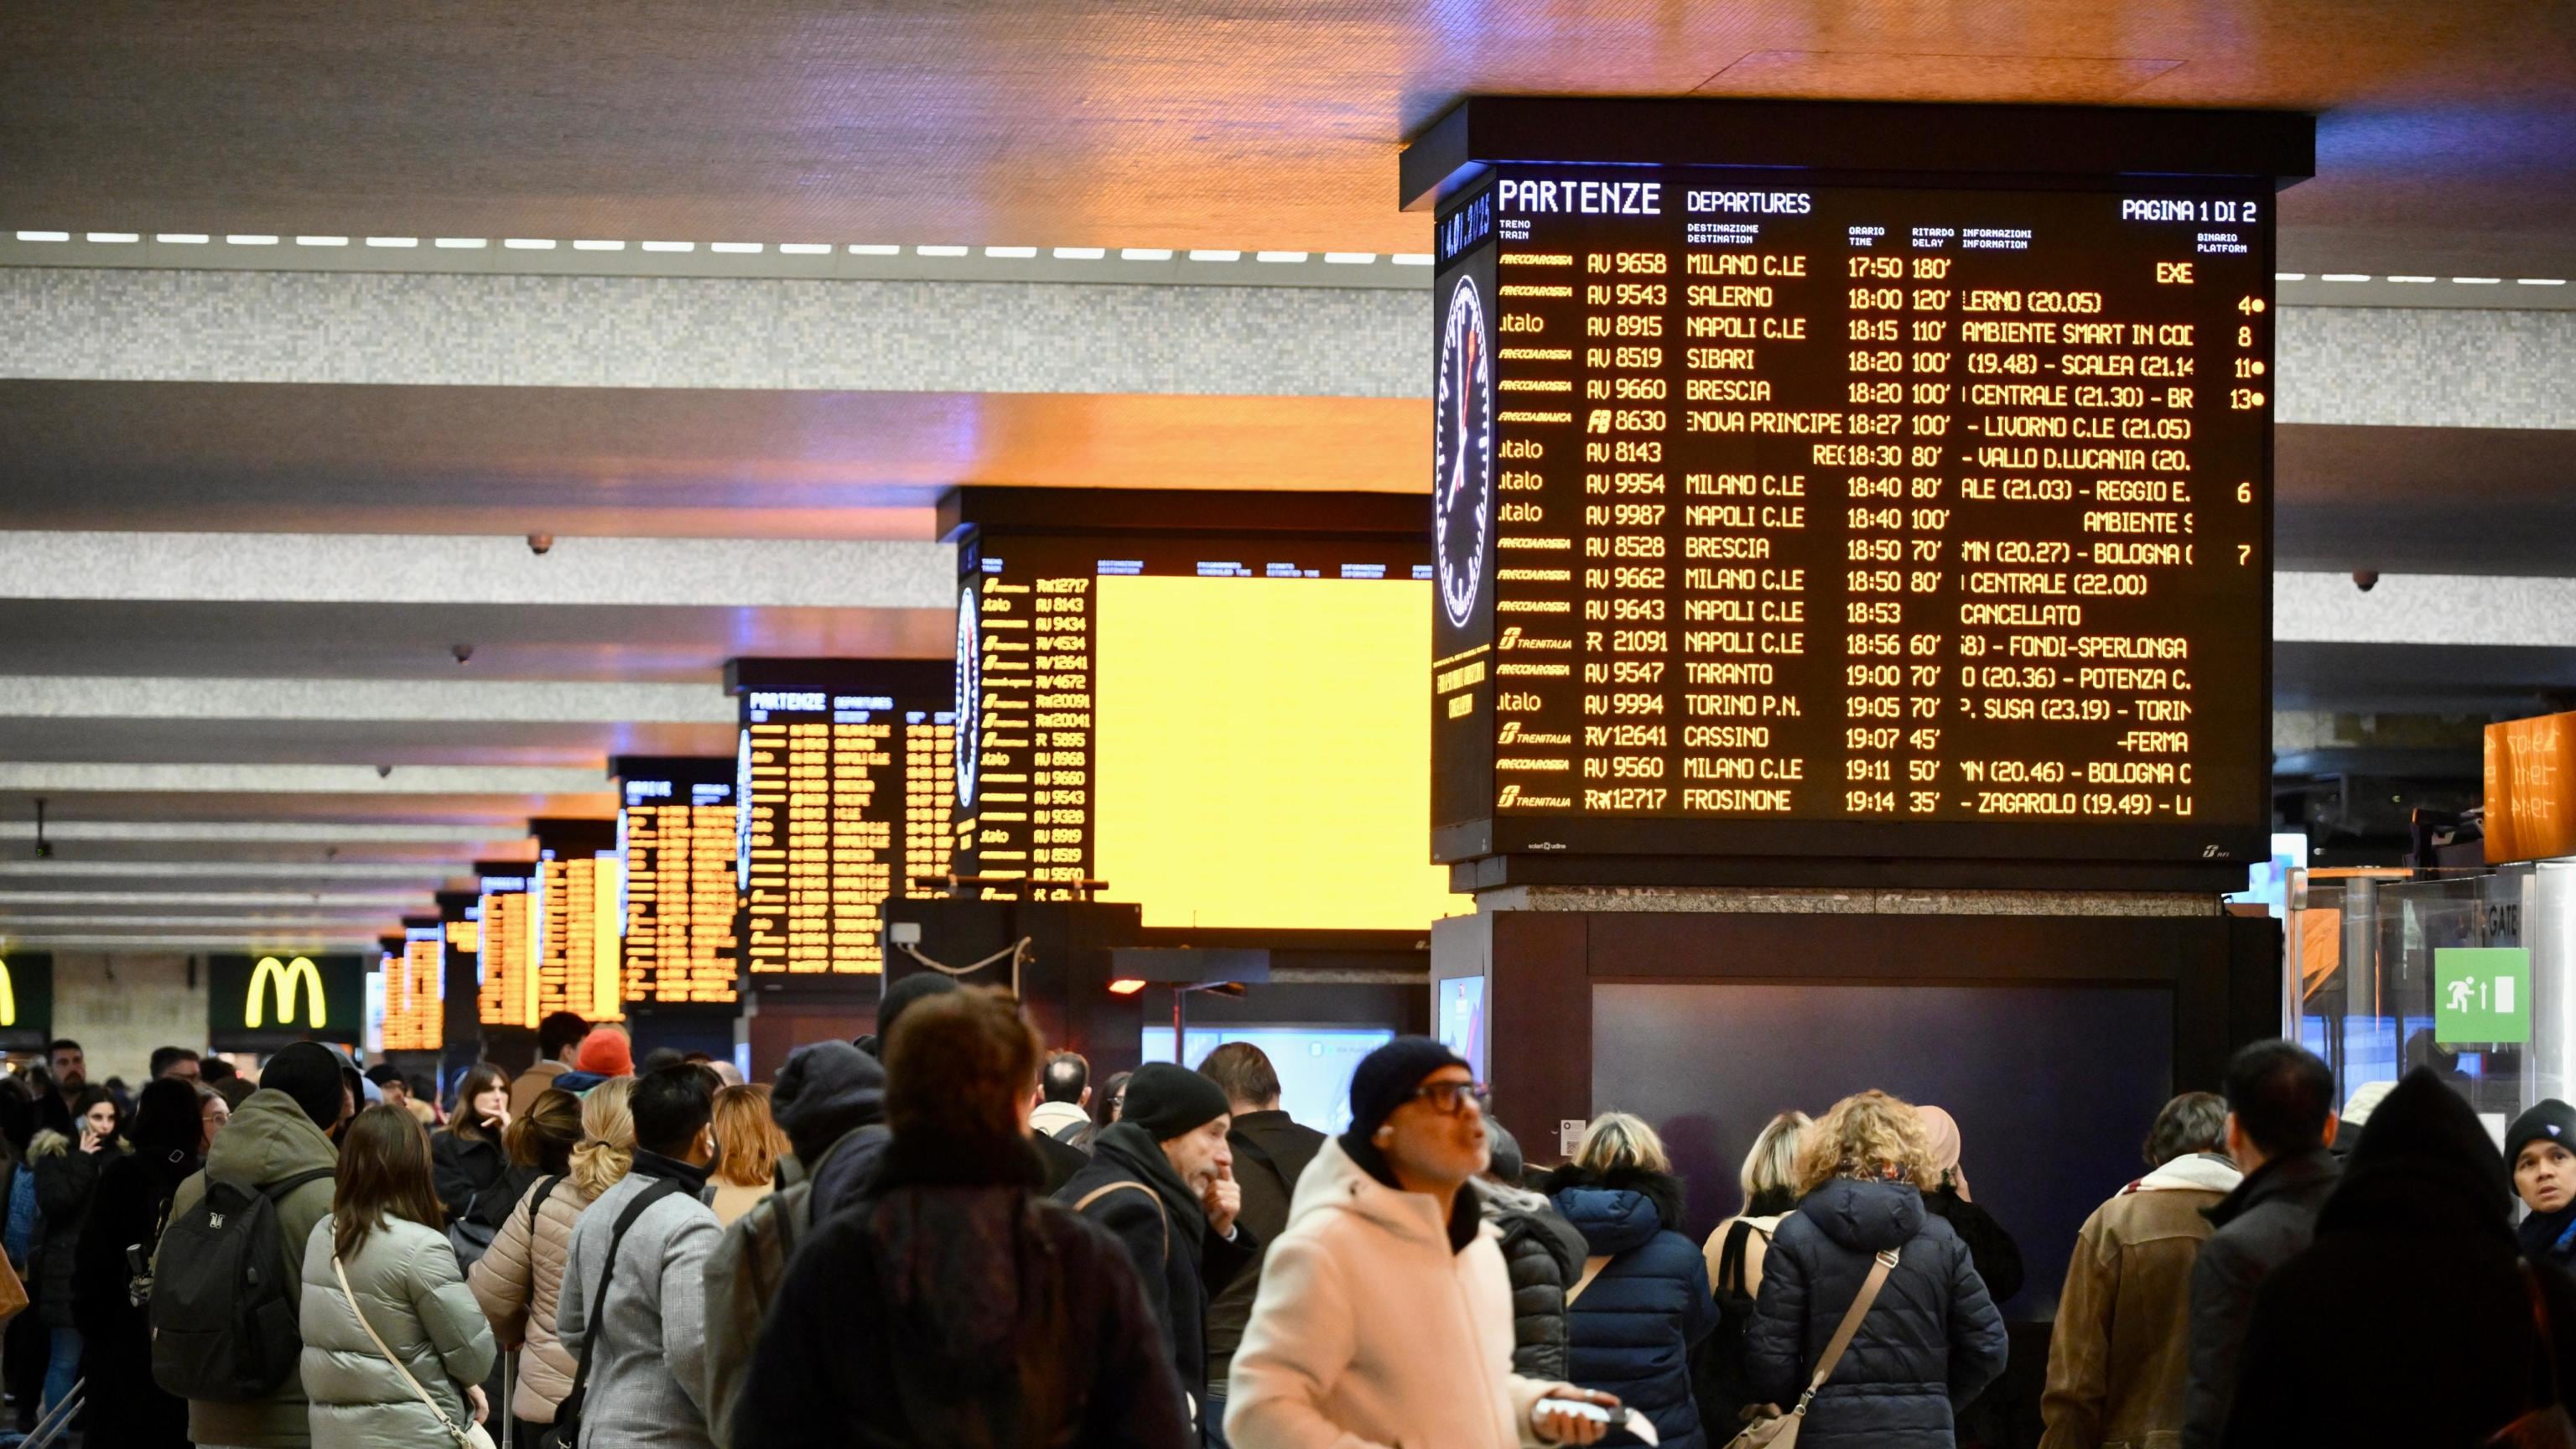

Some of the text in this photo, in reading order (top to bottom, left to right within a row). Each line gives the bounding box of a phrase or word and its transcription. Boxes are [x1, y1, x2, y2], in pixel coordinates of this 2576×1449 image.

[1499, 180, 1810, 214] PARTENZE DEPARTURES
[2123, 200, 2256, 221] PAGINA 1 DI 2
[1499, 220, 1530, 228] TRENO
[1499, 231, 1529, 239] TRAIN
[1688, 224, 1758, 233] DESTINAZIONE
[1913, 228, 1954, 236] RITARDO
[1963, 229, 2032, 238] INFORMAZIONI
[2198, 233, 2237, 242] BINARIO
[1688, 235, 1753, 243] DESTINATION
[1849, 237, 1872, 246] TIME
[1913, 239, 1943, 247] DELAY
[1963, 240, 2027, 248] INFORMATION
[2198, 244, 2246, 252] PLATFORM
[1588, 253, 1611, 273] AV
[1617, 252, 1667, 273] 9658
[1688, 254, 1758, 275] MILANO
[1763, 255, 1806, 276] C.LE
[1849, 257, 1903, 278] 17:50
[2157, 262, 2194, 283] EXE
[1587, 284, 2251, 315] AV 9543 SALERNO 18:00 LERNO (20.05) 4
[1587, 317, 1611, 337] AV
[1616, 315, 1663, 336] 8915
[1687, 316, 1757, 338] NAPOLI
[1763, 318, 1806, 339] C.LE
[1849, 319, 1898, 340] 18:15
[1962, 321, 2056, 343] AMBIENTE
[2063, 323, 2125, 344] SMART
[2132, 325, 2153, 345] IN
[2239, 326, 2251, 346] 8
[1587, 347, 2251, 378] AV 8519 SIBARI 18:20 (19.48) SCALEA 11
[1616, 378, 2251, 409] 9660 BRESCIA 18:20 CENTRALE (21.30) 13
[1616, 410, 1666, 431] 8630
[1751, 412, 1842, 434] PRINCIPE
[1848, 413, 1902, 434] 18:27
[1985, 416, 2066, 438] LIVORNO
[2073, 418, 2115, 439] C.LE
[2122, 418, 2191, 439] (21.05)
[1587, 441, 2146, 470] AV 8143 18:30 VALLO D.LUCANIA
[1615, 473, 2251, 503] 9954 MILANO 18:40 ALE (21.03) REGGIO 6
[1615, 504, 2178, 533] 9987 NAPOLI 18:40 AMBIENTE
[1615, 536, 1665, 558] 8528
[1685, 537, 1769, 558] BRESCIA
[1848, 539, 1902, 561] 18:50
[1997, 542, 2070, 563] (20.27)
[2095, 543, 2180, 564] BOLOGNA
[2238, 545, 2251, 565] 7
[1615, 567, 2148, 595] 9662 MILANO 18:50 CENTRALE (22.00)
[1586, 599, 2081, 626] AV 9643 NAPOLI 18:53 CANCELLATO
[1518, 631, 2188, 659] TRENITALIA R 21091 NAPOLI 18:56 FONDI-SPERLONGA
[1613, 662, 2167, 689] 9547 TARANTO 19:00 (20.36) POTENZA
[1585, 693, 2111, 720] AV 9994 TORINO P.N. 19:05 SUSA (23.19)
[1517, 734, 1572, 744] TRENITALIA
[1685, 725, 1769, 748] CASSINO
[1846, 728, 1900, 749] 19:07
[1584, 756, 2174, 783] AV 9560 MILANO C.LE 19:11 (20.46) BOLOGNA
[1517, 797, 1571, 808] TRENITALIA
[1684, 789, 1791, 811] FROSINONE
[1846, 791, 1895, 812] 19:14
[1979, 792, 2077, 813] ZAGAROLO
[2083, 794, 2152, 815] (19.49)
